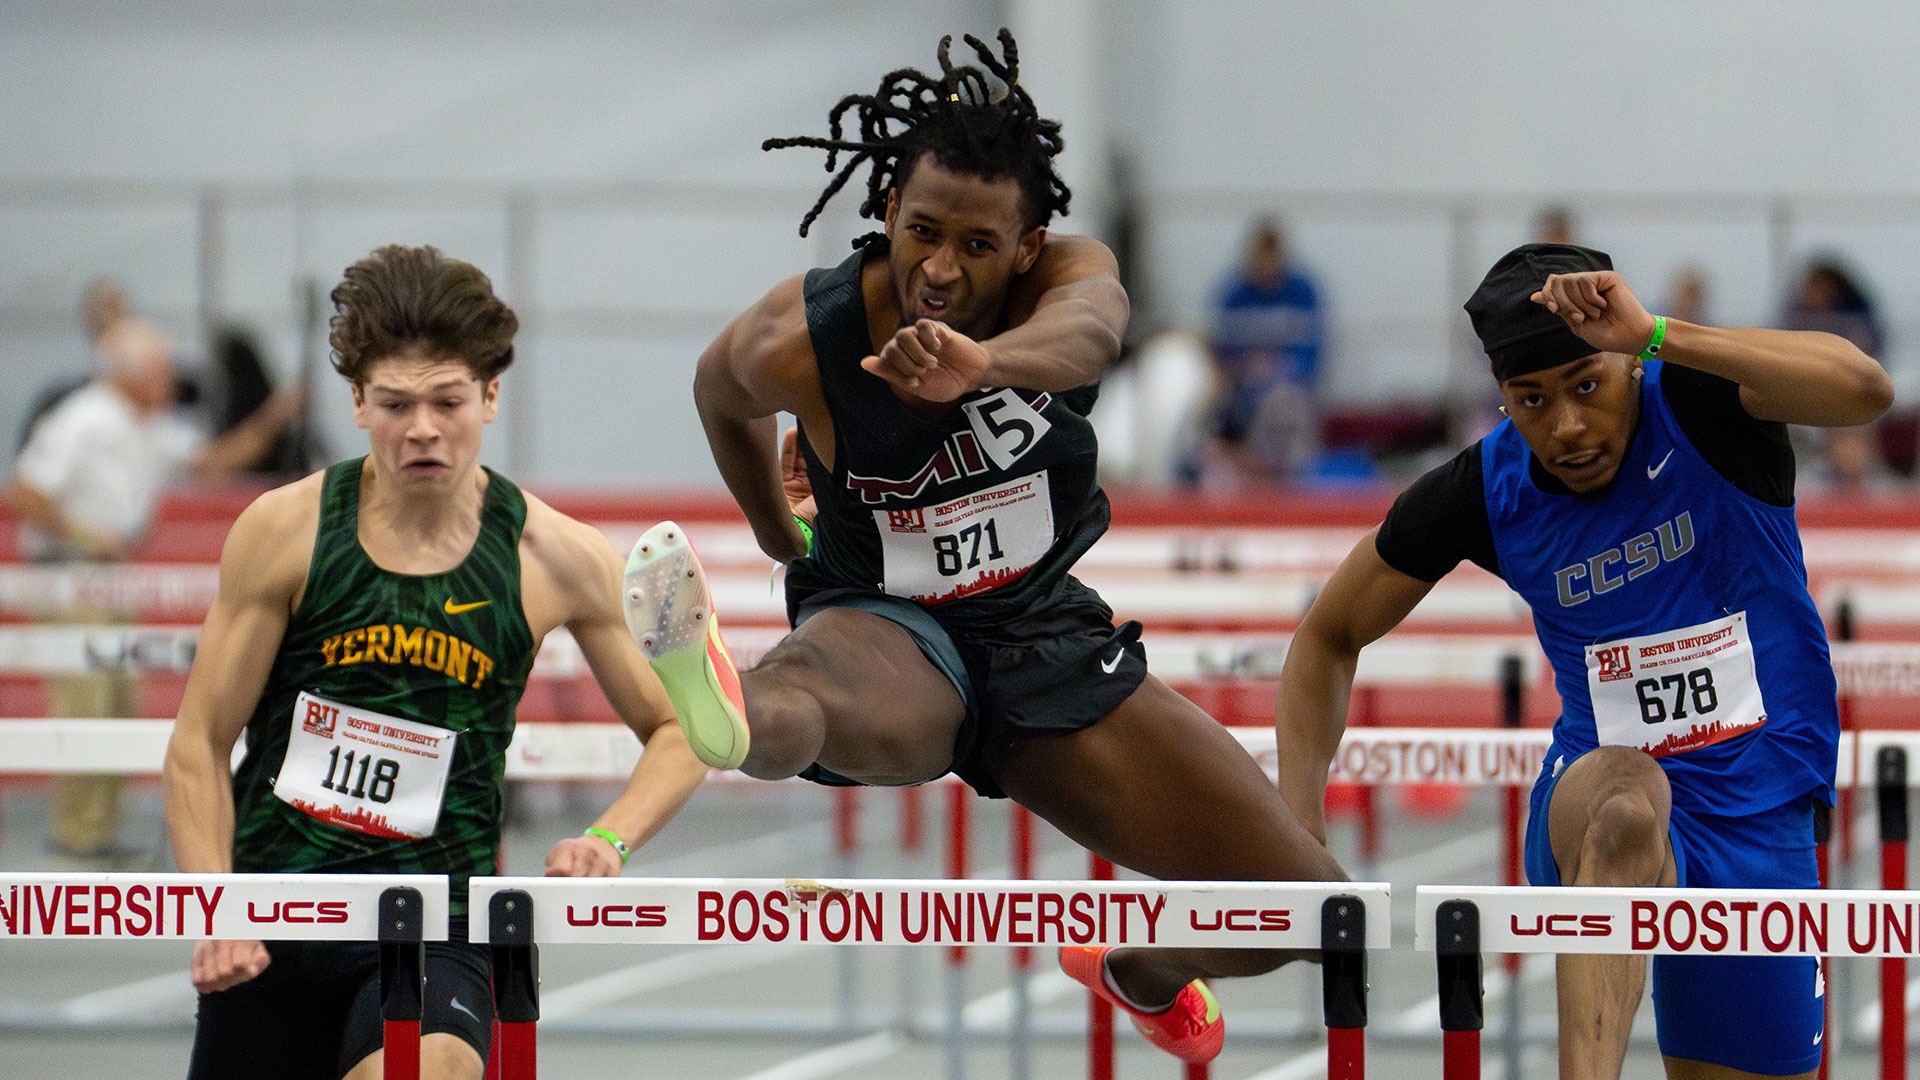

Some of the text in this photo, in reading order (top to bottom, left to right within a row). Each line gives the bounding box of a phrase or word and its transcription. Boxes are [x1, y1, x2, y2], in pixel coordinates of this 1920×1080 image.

[976, 397, 1035, 458] 5
[888, 507, 926, 528] BU
[935, 481, 1032, 517] BOSTON UNIVERSITY
[933, 517, 1004, 577] 871
[1554, 510, 1695, 608] CCSU
[321, 623, 495, 690] VERMONT
[1595, 645, 1632, 676] BU
[1639, 625, 1733, 658] BOSTON UNIVERSITY
[304, 700, 340, 732] BU
[1635, 666, 1718, 725] 678
[346, 716, 382, 734] BOSTON
[382, 725, 440, 748] UNIVERSITY
[320, 744, 400, 804] 1118
[247, 901, 349, 924] UCS
[566, 889, 1291, 944] UCS BOSTON UNIVERSITY UCS
[1510, 913, 1613, 936] UCS
[1631, 900, 1828, 953] BOSTON
